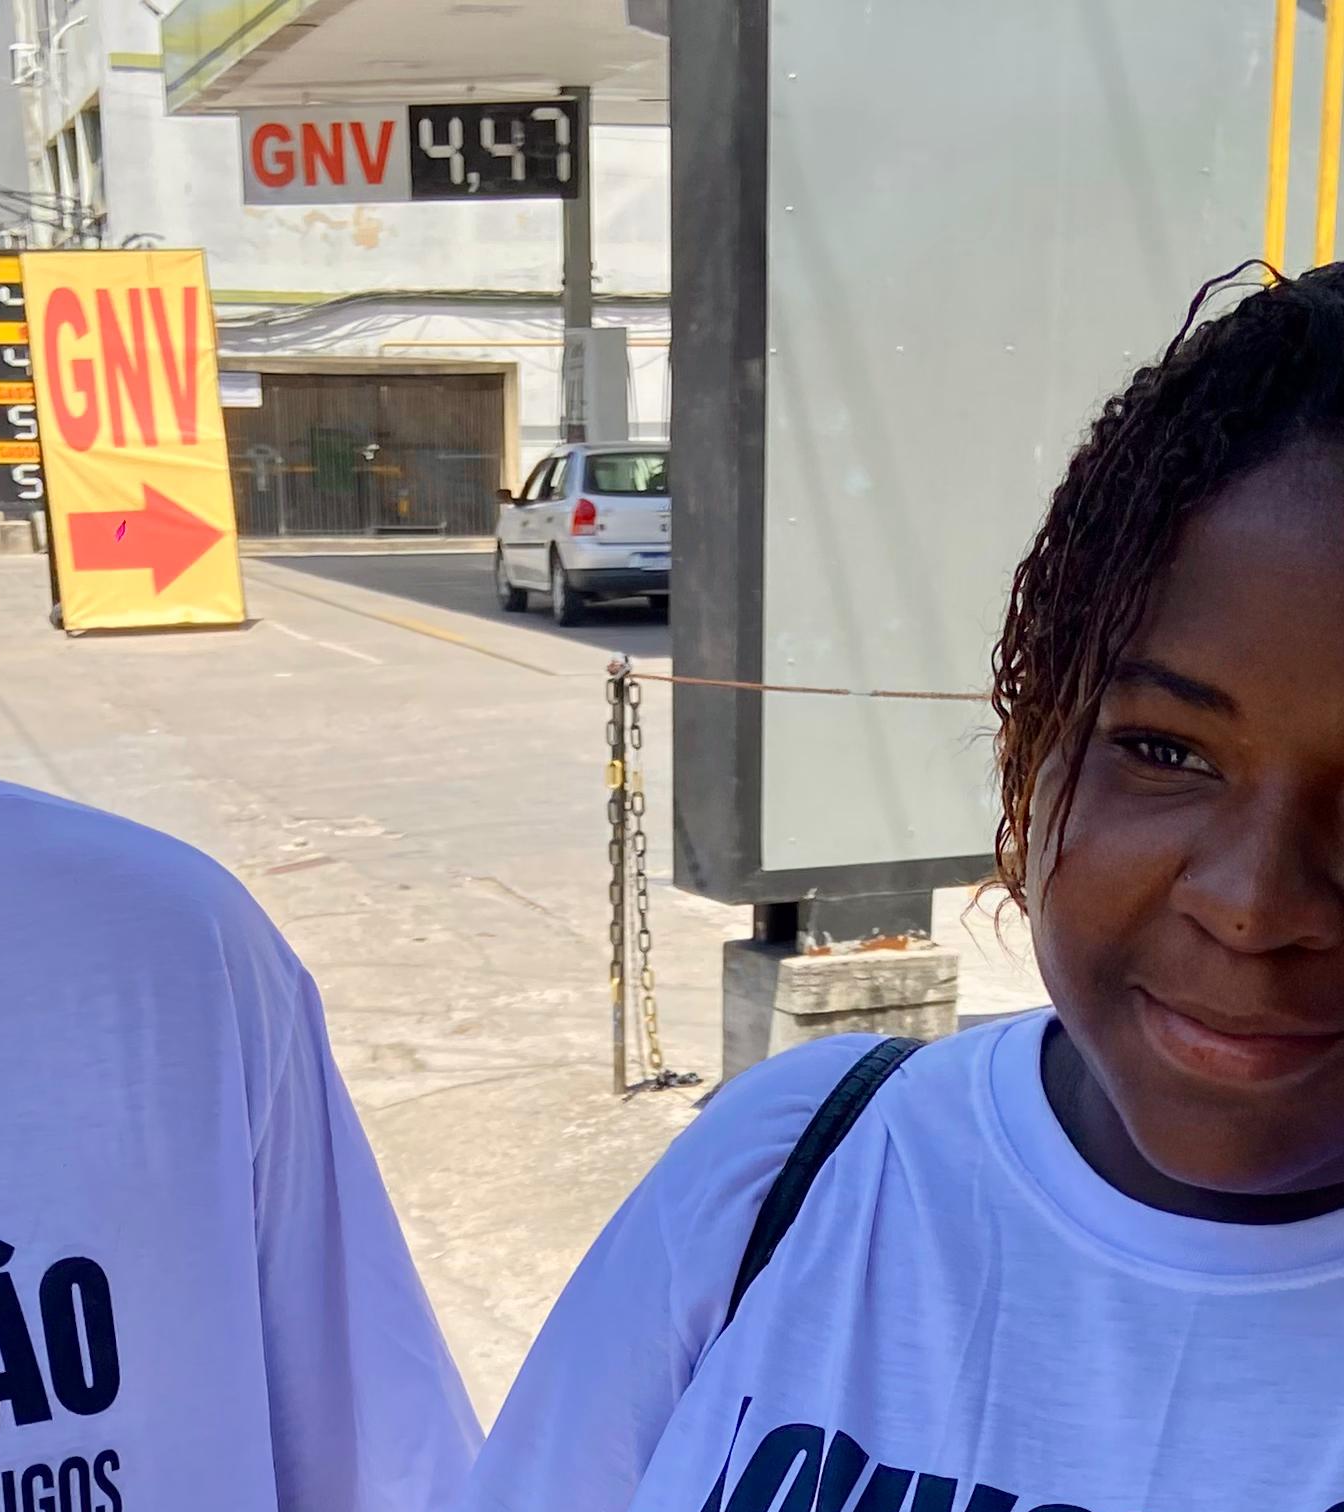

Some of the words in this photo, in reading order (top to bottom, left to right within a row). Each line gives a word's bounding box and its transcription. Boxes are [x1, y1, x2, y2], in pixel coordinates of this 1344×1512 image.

[250, 120, 395, 188] GNV
[418, 107, 570, 193] 4,47
[44, 286, 199, 452] GNV
